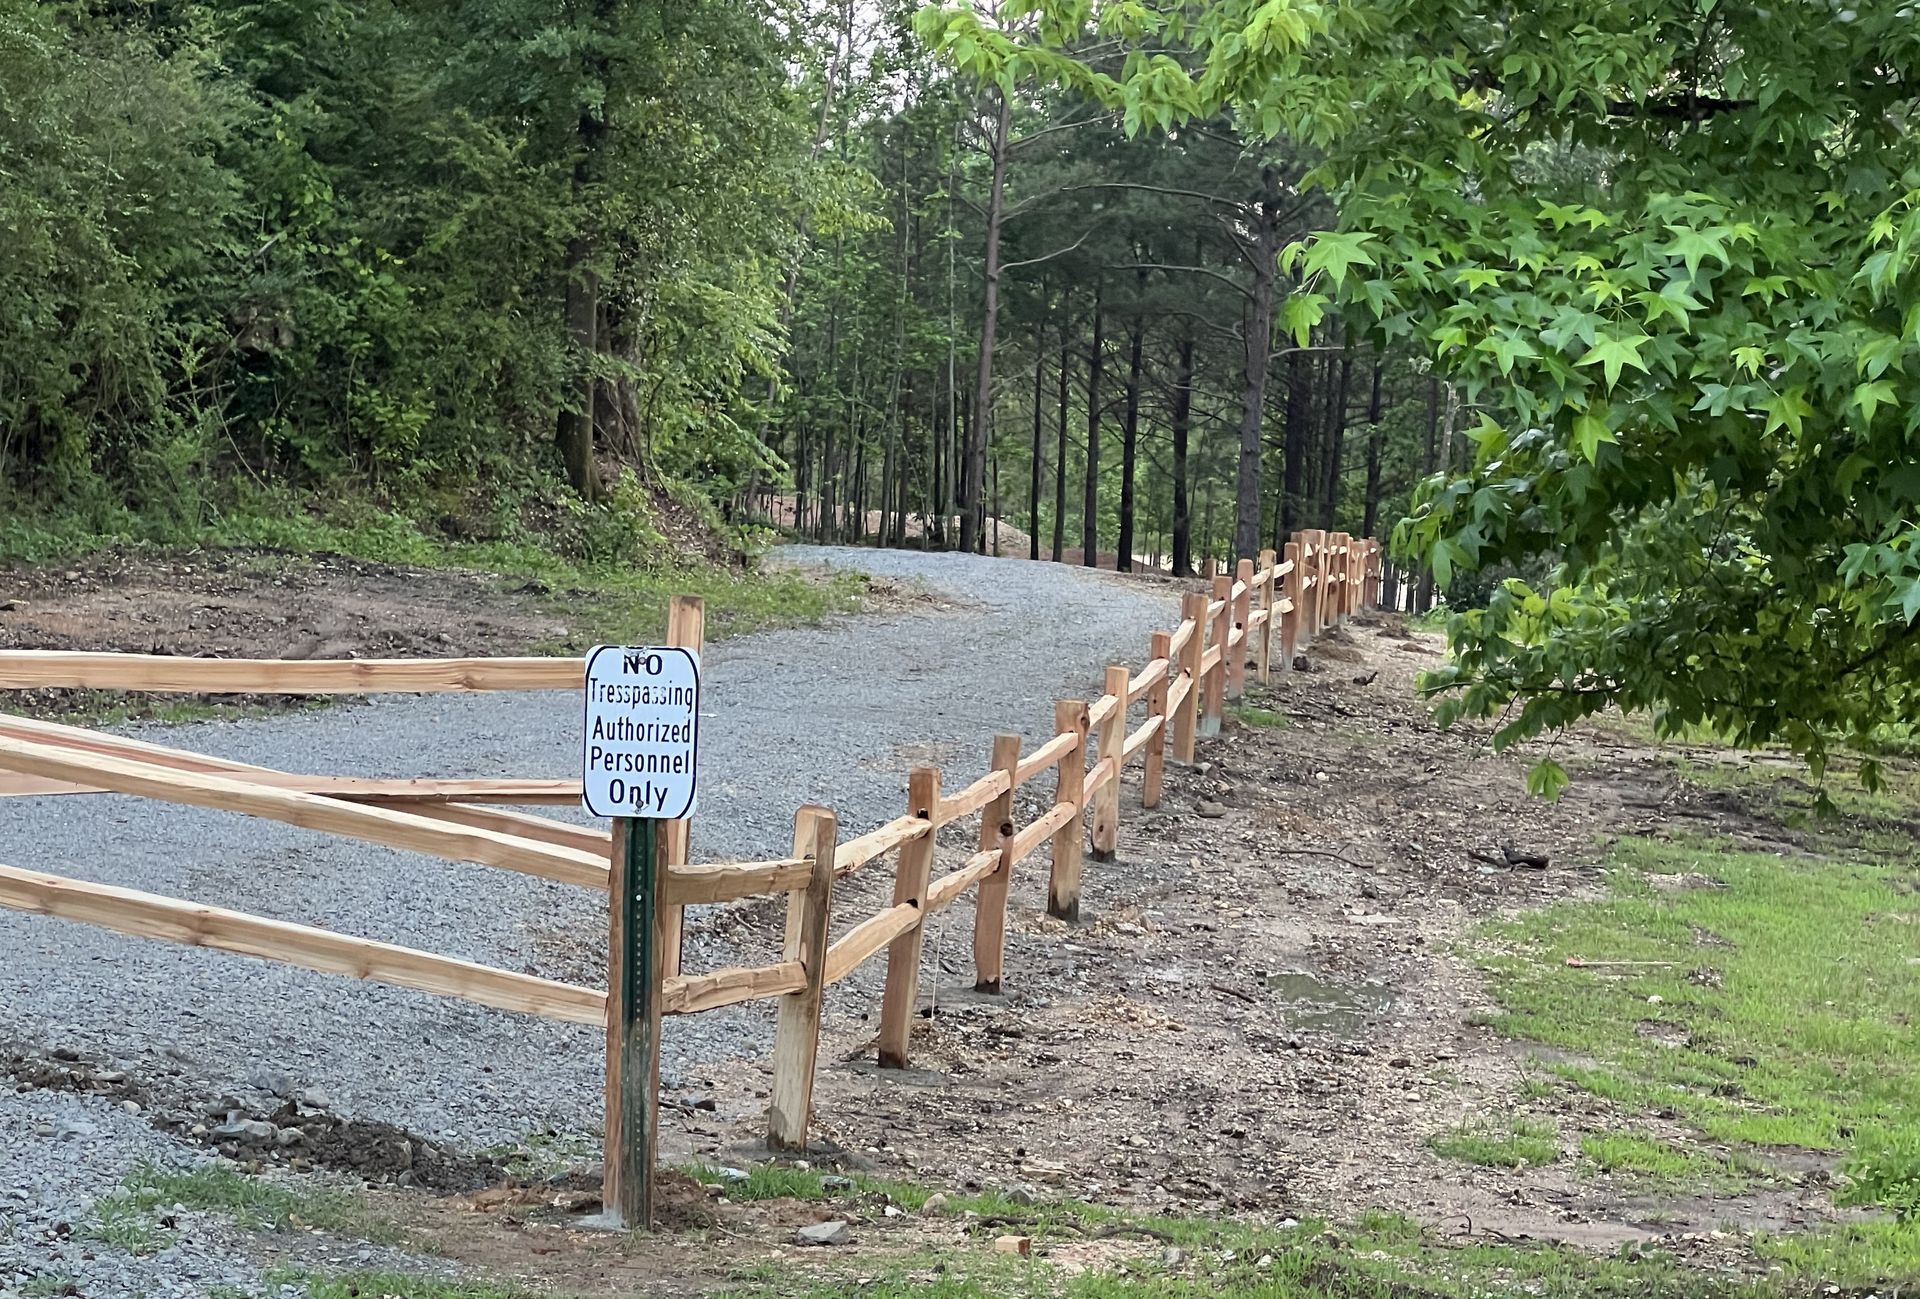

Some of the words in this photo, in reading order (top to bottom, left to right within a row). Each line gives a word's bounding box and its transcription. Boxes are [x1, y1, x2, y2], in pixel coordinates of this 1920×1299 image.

[623, 654, 662, 675] NO
[590, 678, 693, 714] Tresspassing
[592, 715, 691, 743] Authorized
[591, 746, 689, 774] Personnel
[609, 779, 668, 812] Only
